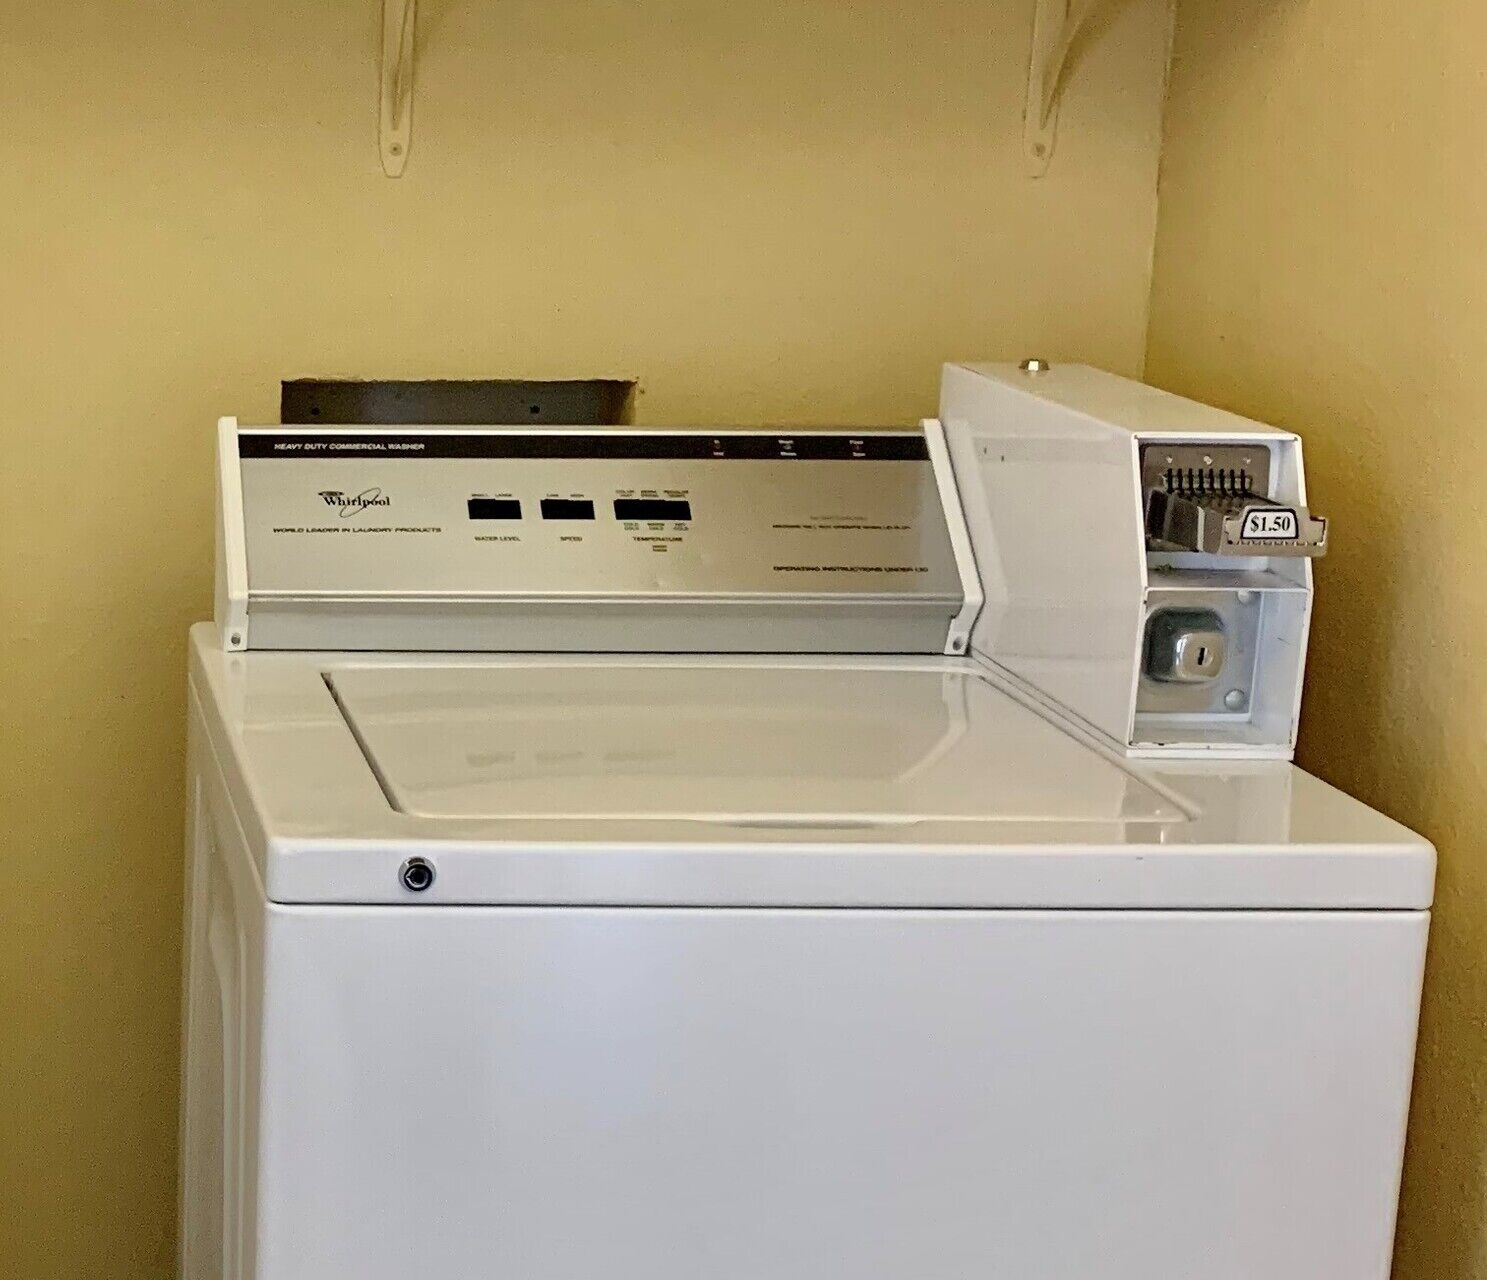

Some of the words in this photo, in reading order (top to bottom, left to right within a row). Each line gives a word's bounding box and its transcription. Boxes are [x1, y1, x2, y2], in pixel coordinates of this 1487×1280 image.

[329, 443, 387, 451] COMMERCIAL
[387, 443, 426, 451] WASHER
[322, 496, 391, 509] Whirlpool
[1250, 515, 1290, 533] $1.50
